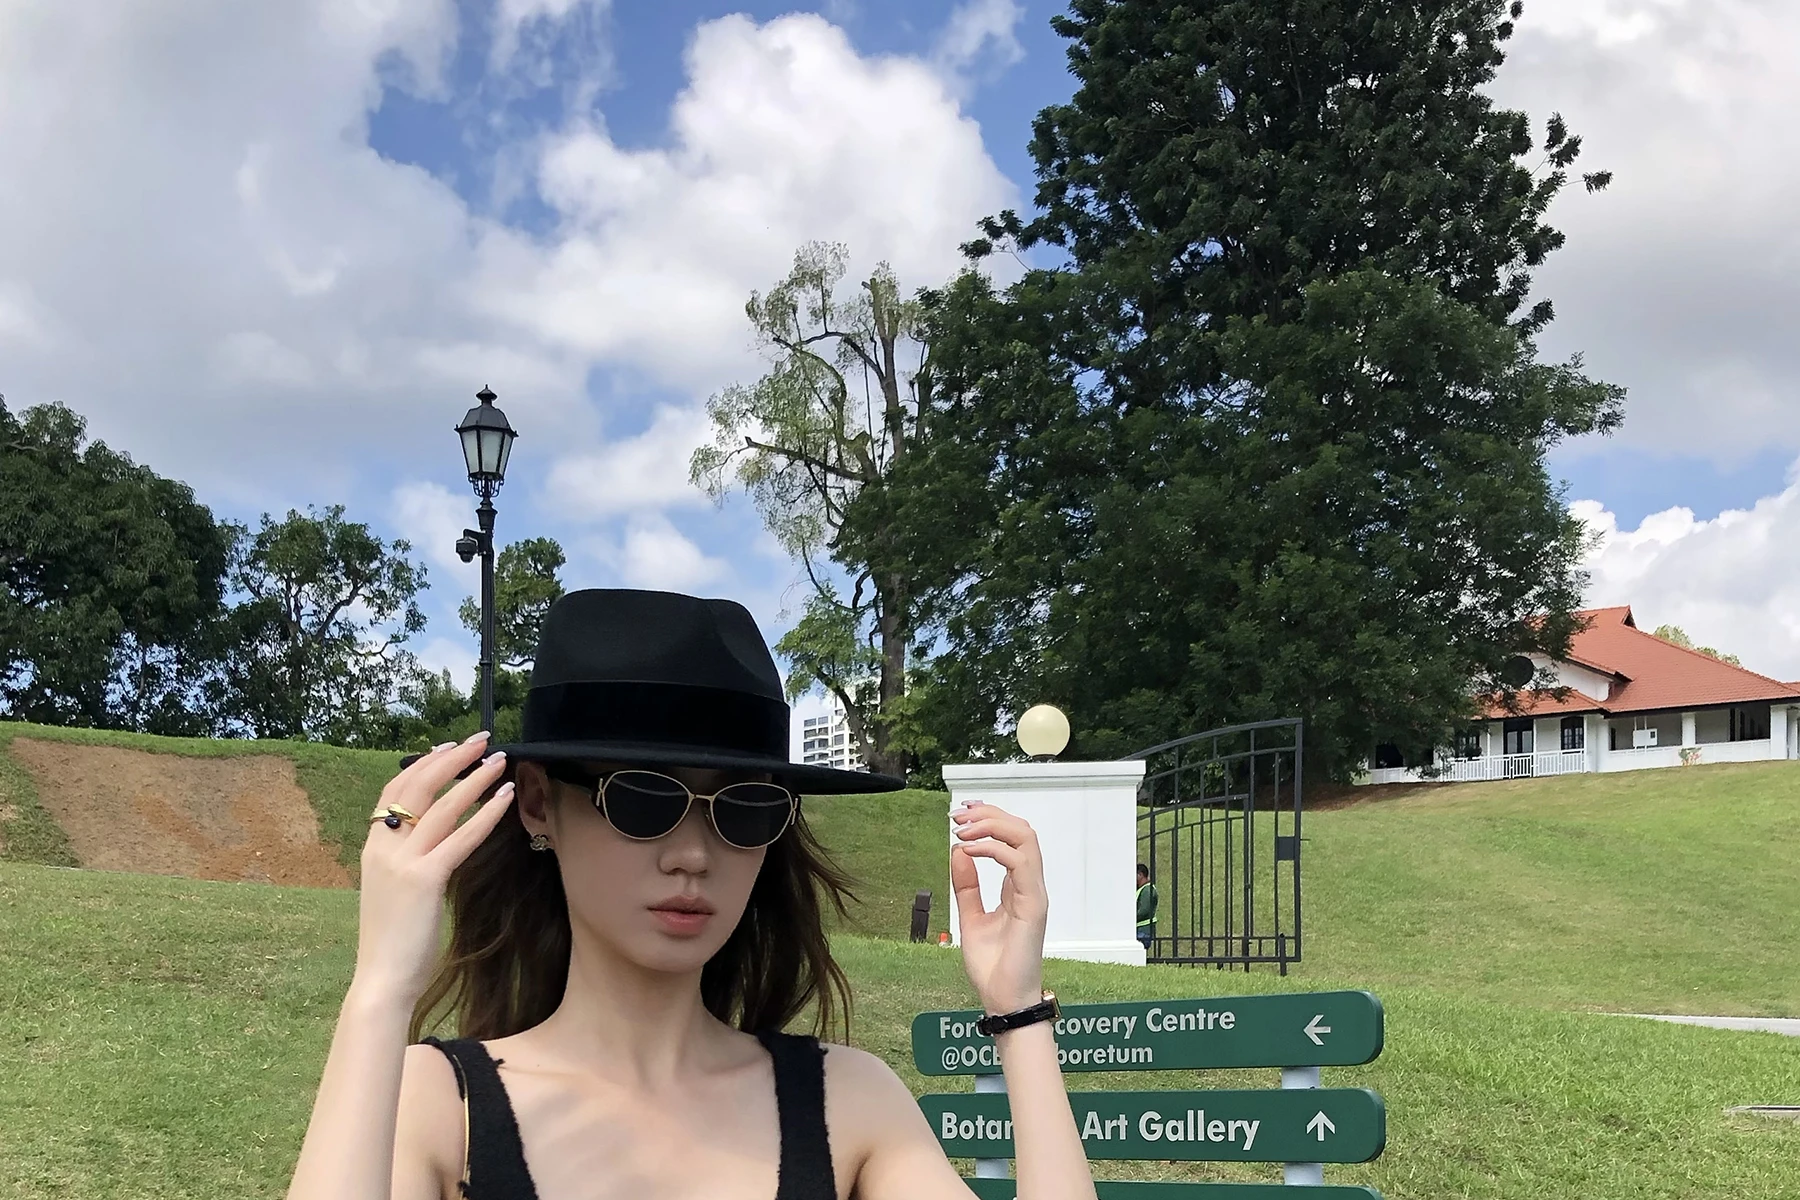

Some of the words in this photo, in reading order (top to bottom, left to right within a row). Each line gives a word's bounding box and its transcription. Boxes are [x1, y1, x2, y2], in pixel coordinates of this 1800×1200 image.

[940, 1016, 994, 1039] For
[1054, 1015, 1138, 1040] covery
[1146, 1007, 1236, 1032] Centre
[1056, 1043, 1154, 1066] boretum
[941, 1111, 1014, 1141] Botan
[1081, 1110, 1129, 1141] Art
[1138, 1109, 1261, 1151] Gallery
